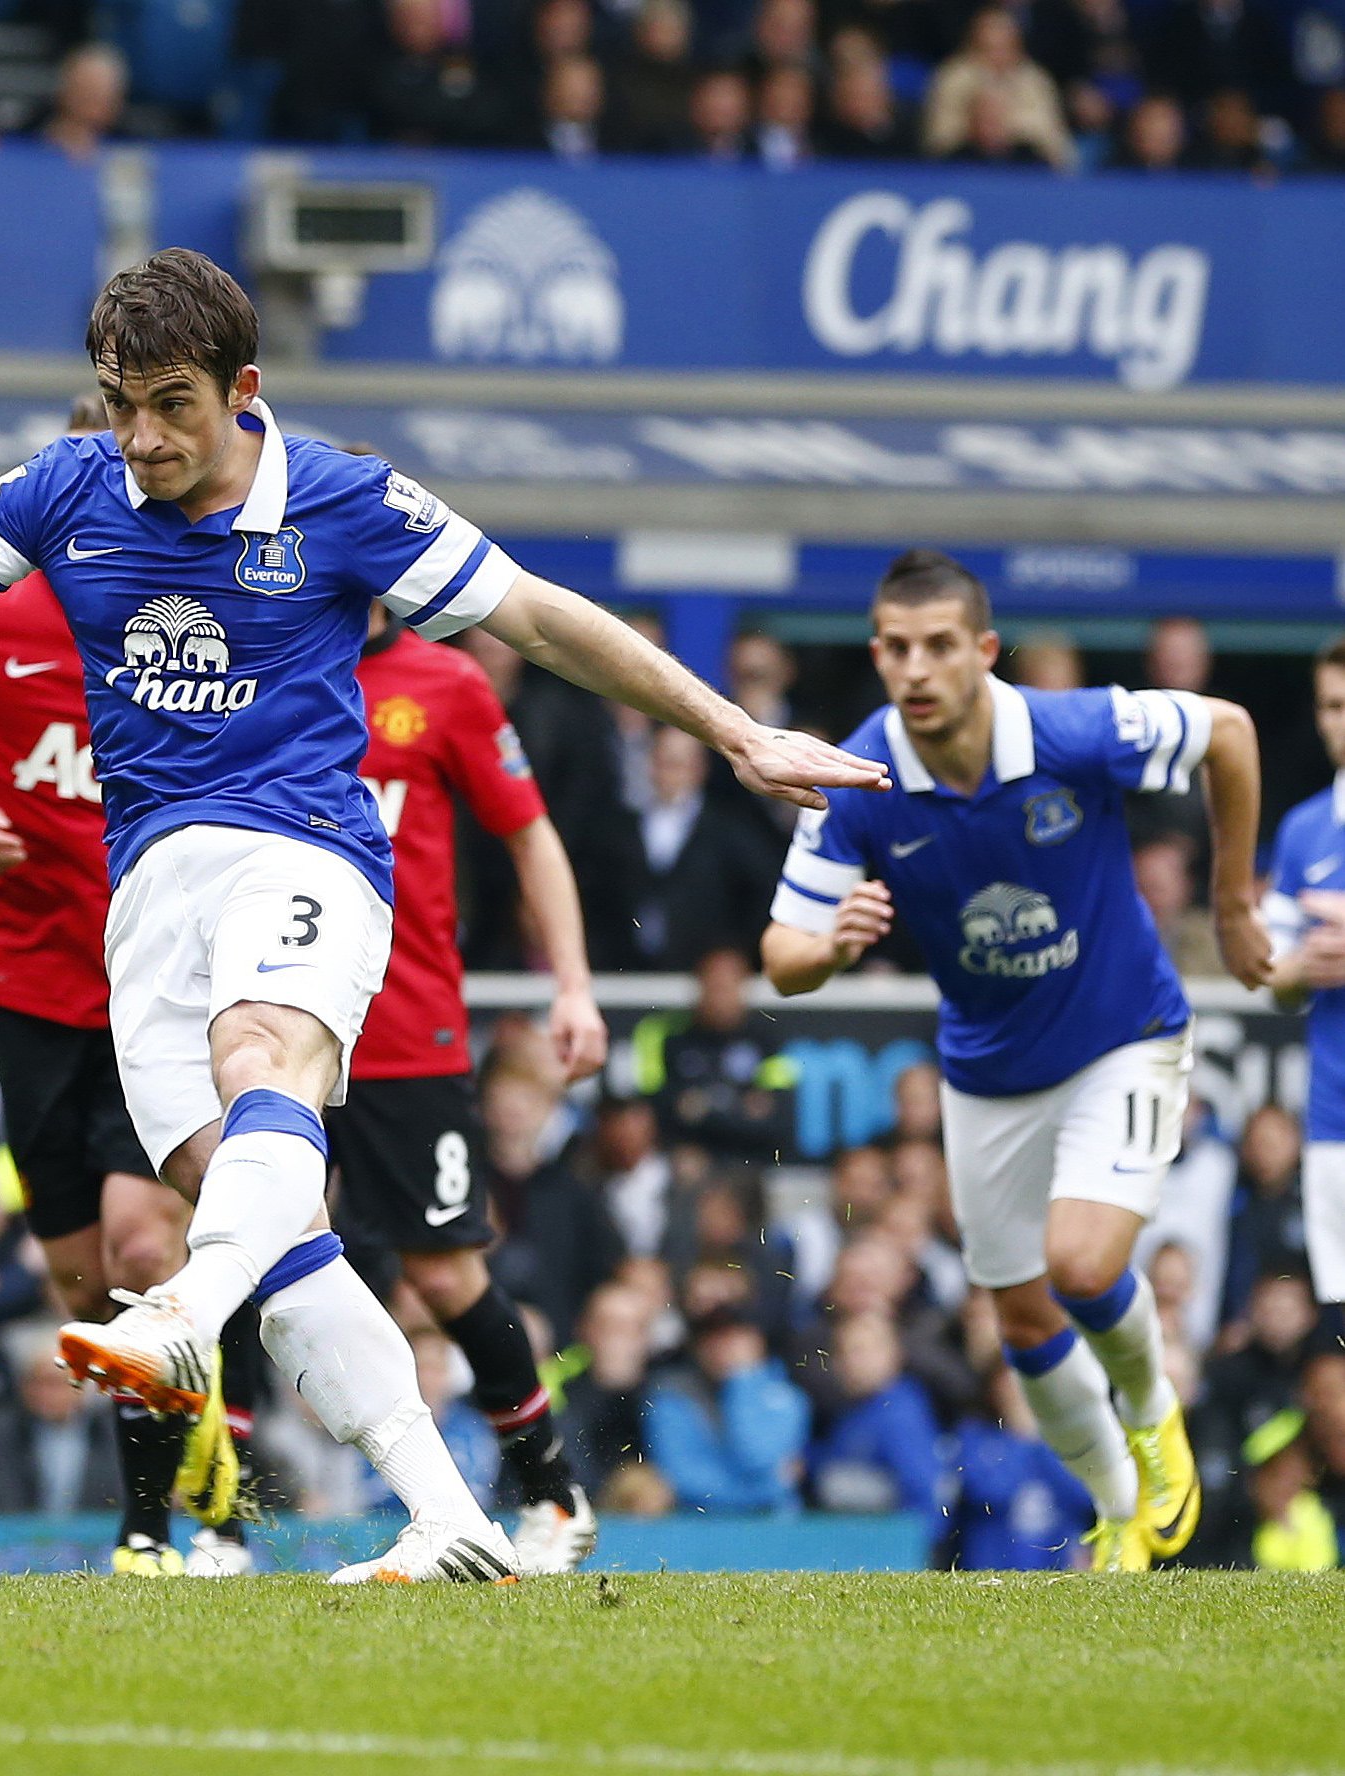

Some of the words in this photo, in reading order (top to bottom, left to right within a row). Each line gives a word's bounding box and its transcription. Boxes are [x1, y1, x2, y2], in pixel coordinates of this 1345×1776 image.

[801, 190, 1211, 391] Chang
[244, 567, 296, 584] Everton
[280, 894, 323, 947] 3
[958, 928, 1080, 978] Chang
[1124, 1090, 1161, 1155] 11
[435, 1130, 471, 1206] 8
